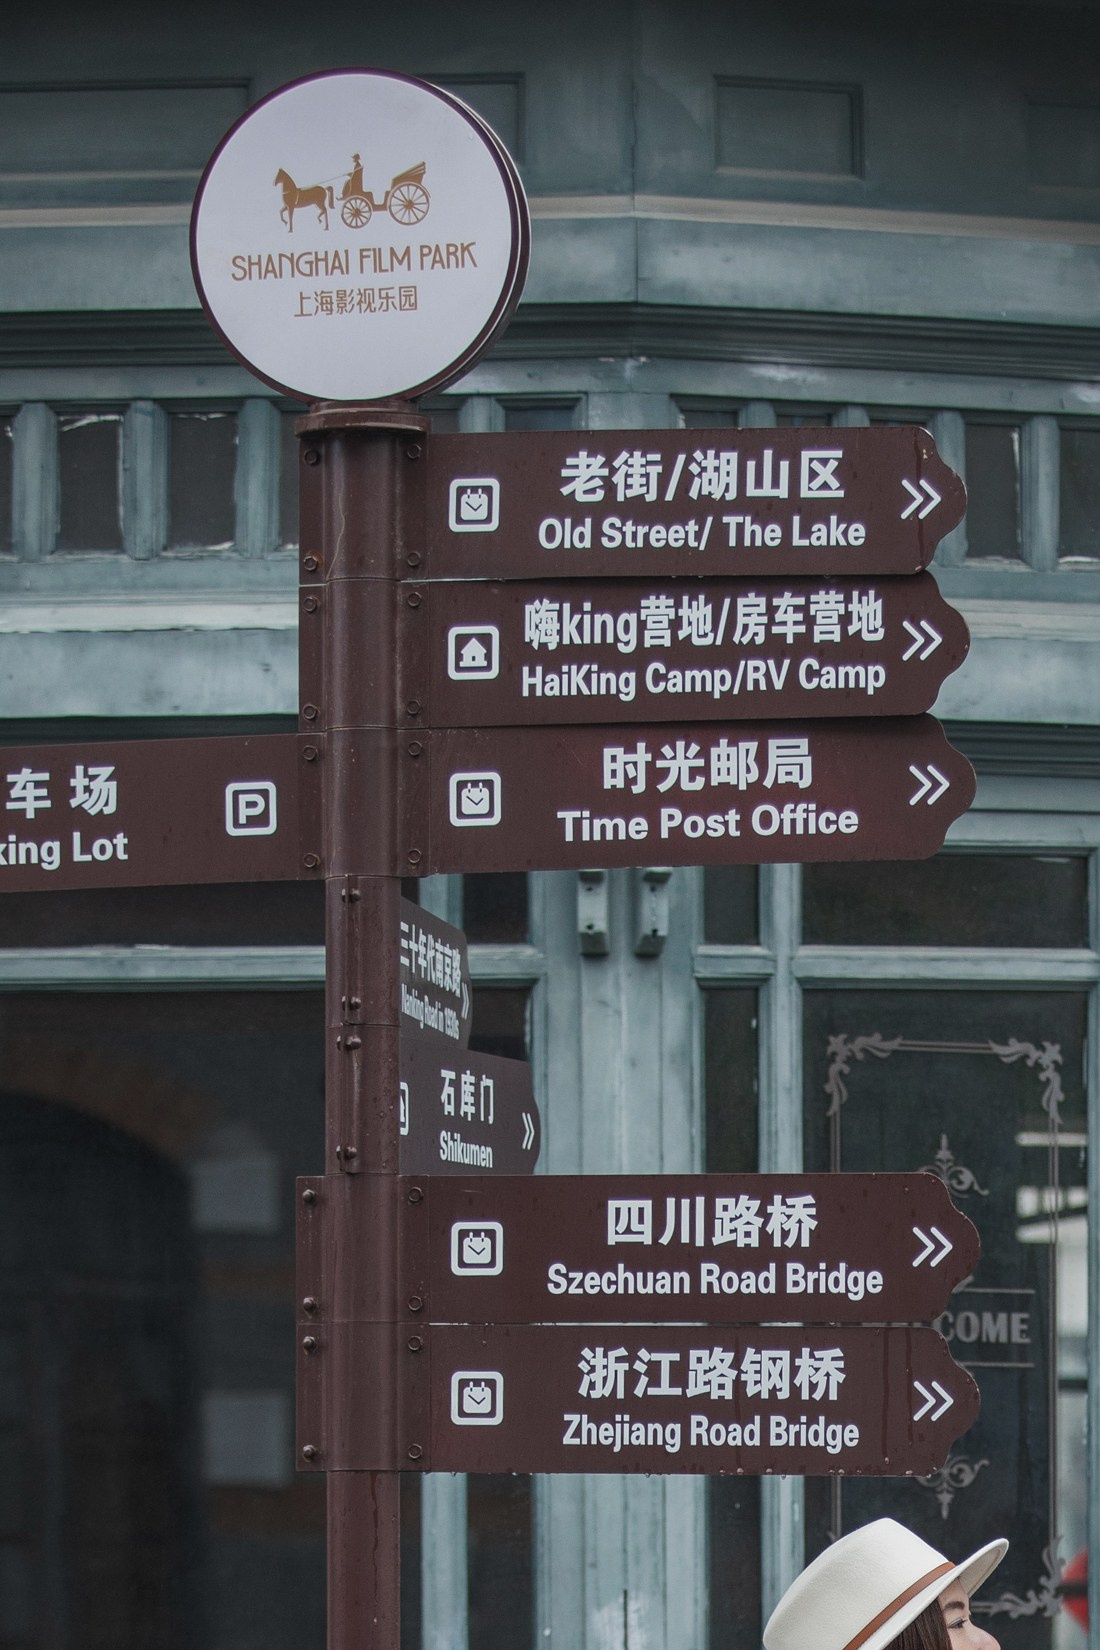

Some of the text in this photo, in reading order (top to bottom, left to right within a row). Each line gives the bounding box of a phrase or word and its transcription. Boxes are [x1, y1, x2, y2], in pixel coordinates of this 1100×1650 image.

[231, 241, 478, 282] SHANGHAI FILM PARK
[293, 285, 418, 318] 上海影视乐园
[559, 449, 845, 503] 老街/湖山区
[538, 514, 866, 551] Old Street/ The Lake
[524, 589, 885, 654] 嗨king营地/房车营地
[522, 657, 886, 702] HaiKing Camp/RV Camp
[603, 738, 813, 794] 时光邮局
[238, 793, 266, 825] P
[556, 803, 859, 842] Time Post Office
[72, 831, 129, 862] Lot
[424, 995, 438, 1030] Road
[440, 1069, 494, 1125] 石库门
[439, 1130, 493, 1169] Shikumen
[607, 1194, 819, 1249] 四川路桥
[547, 1262, 884, 1301] Szechuan Road Bridge
[932, 1310, 1031, 1344] COME
[577, 1346, 847, 1401] 浙江路钢桥
[562, 1413, 860, 1455] Zhejiang Road Bridge
